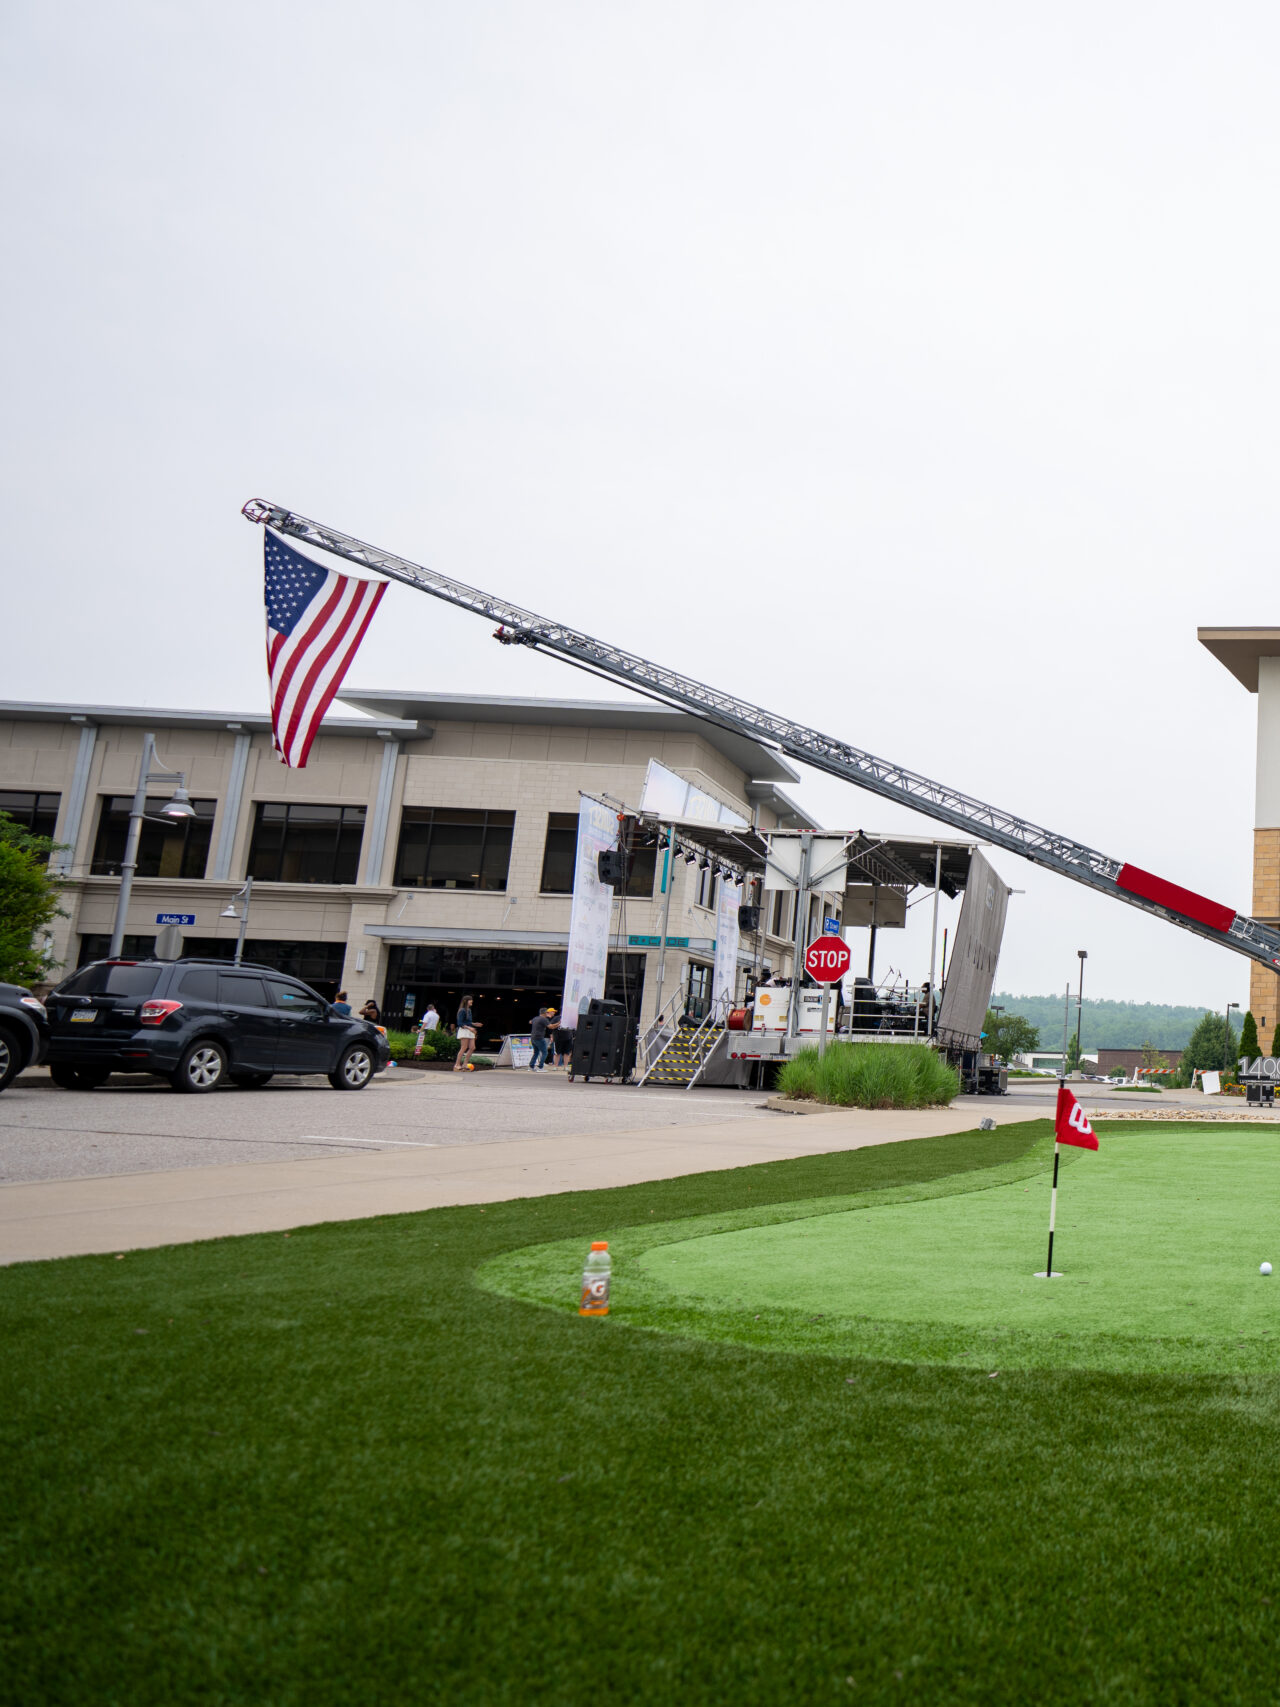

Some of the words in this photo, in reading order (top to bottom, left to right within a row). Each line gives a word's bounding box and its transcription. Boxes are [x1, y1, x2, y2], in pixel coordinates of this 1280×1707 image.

[161, 915, 180, 924] Main
[181, 915, 189, 924] St
[808, 950, 848, 968] STOP
